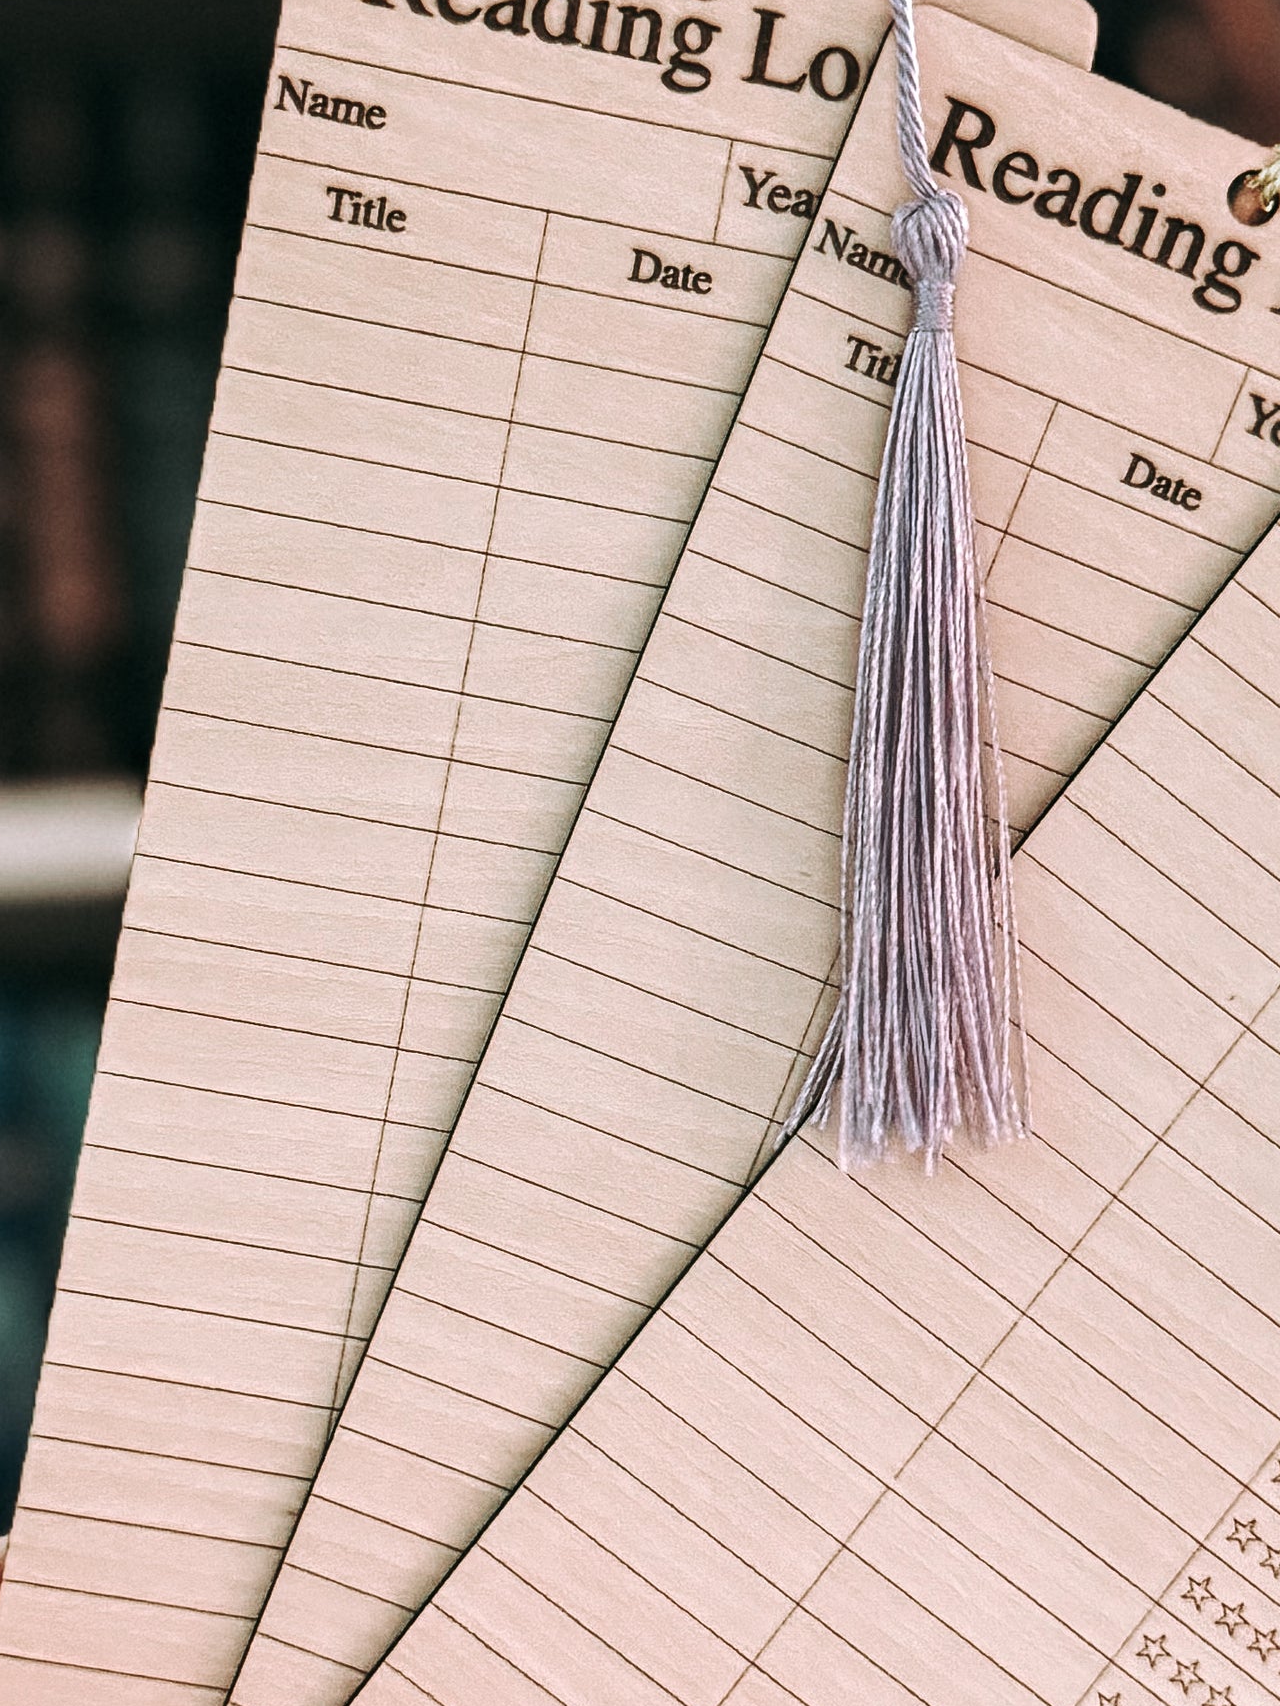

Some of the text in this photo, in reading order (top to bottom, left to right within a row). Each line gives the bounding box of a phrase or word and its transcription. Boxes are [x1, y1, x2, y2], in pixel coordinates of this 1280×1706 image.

[742, 8, 861, 103] Lo
[273, 74, 388, 131] Name
[325, 185, 409, 234] Title
[738, 166, 818, 220] Yea
[928, 96, 1260, 315] Reading
[627, 248, 713, 295] Date
[1120, 453, 1204, 513] Date
